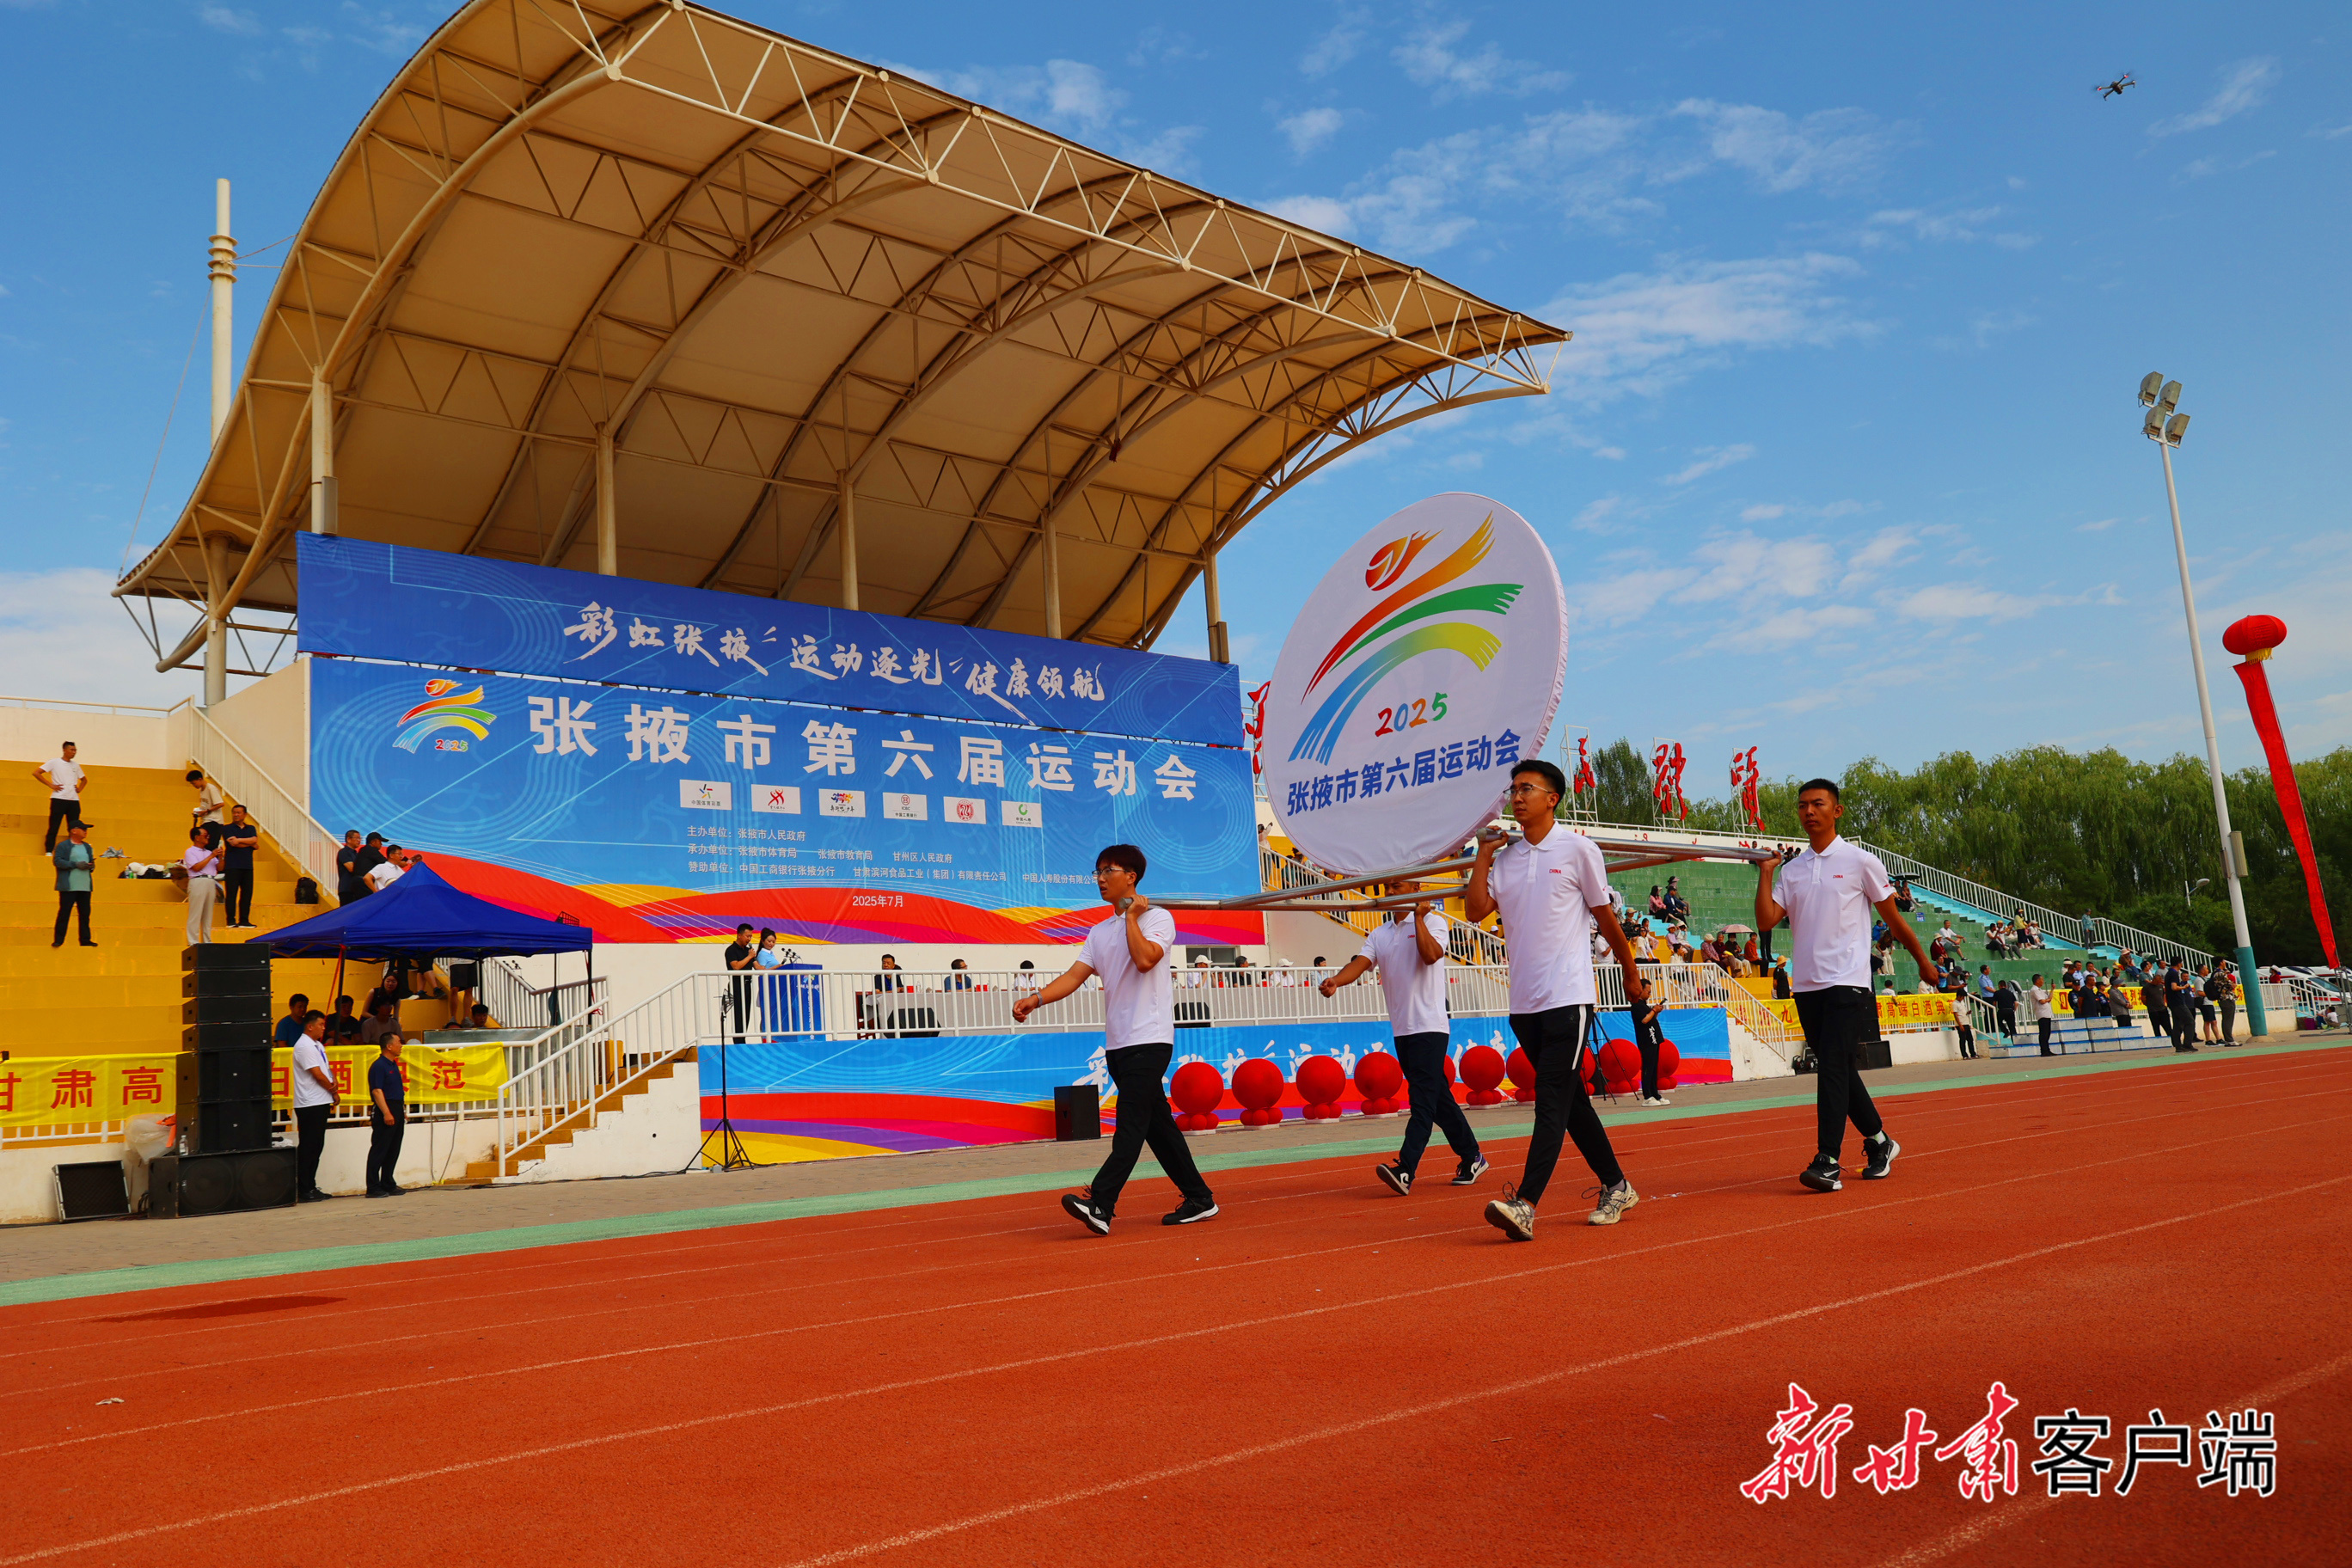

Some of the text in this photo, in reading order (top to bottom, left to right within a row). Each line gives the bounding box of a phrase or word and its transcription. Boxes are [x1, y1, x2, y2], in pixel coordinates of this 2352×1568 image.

[563, 601, 1105, 725] 彩虹张掖 运动逐光 健康领航
[1375, 692, 1449, 738] 2025
[435, 739, 469, 752] 2025
[528, 695, 1197, 800] 张掖市第六届运动会
[1287, 728, 1521, 817] 张掖市第六届运动会
[818, 848, 873, 861] 张掖市教育局
[892, 851, 953, 864] 甘州区人民政府
[852, 894, 903, 908] 2025年7月
